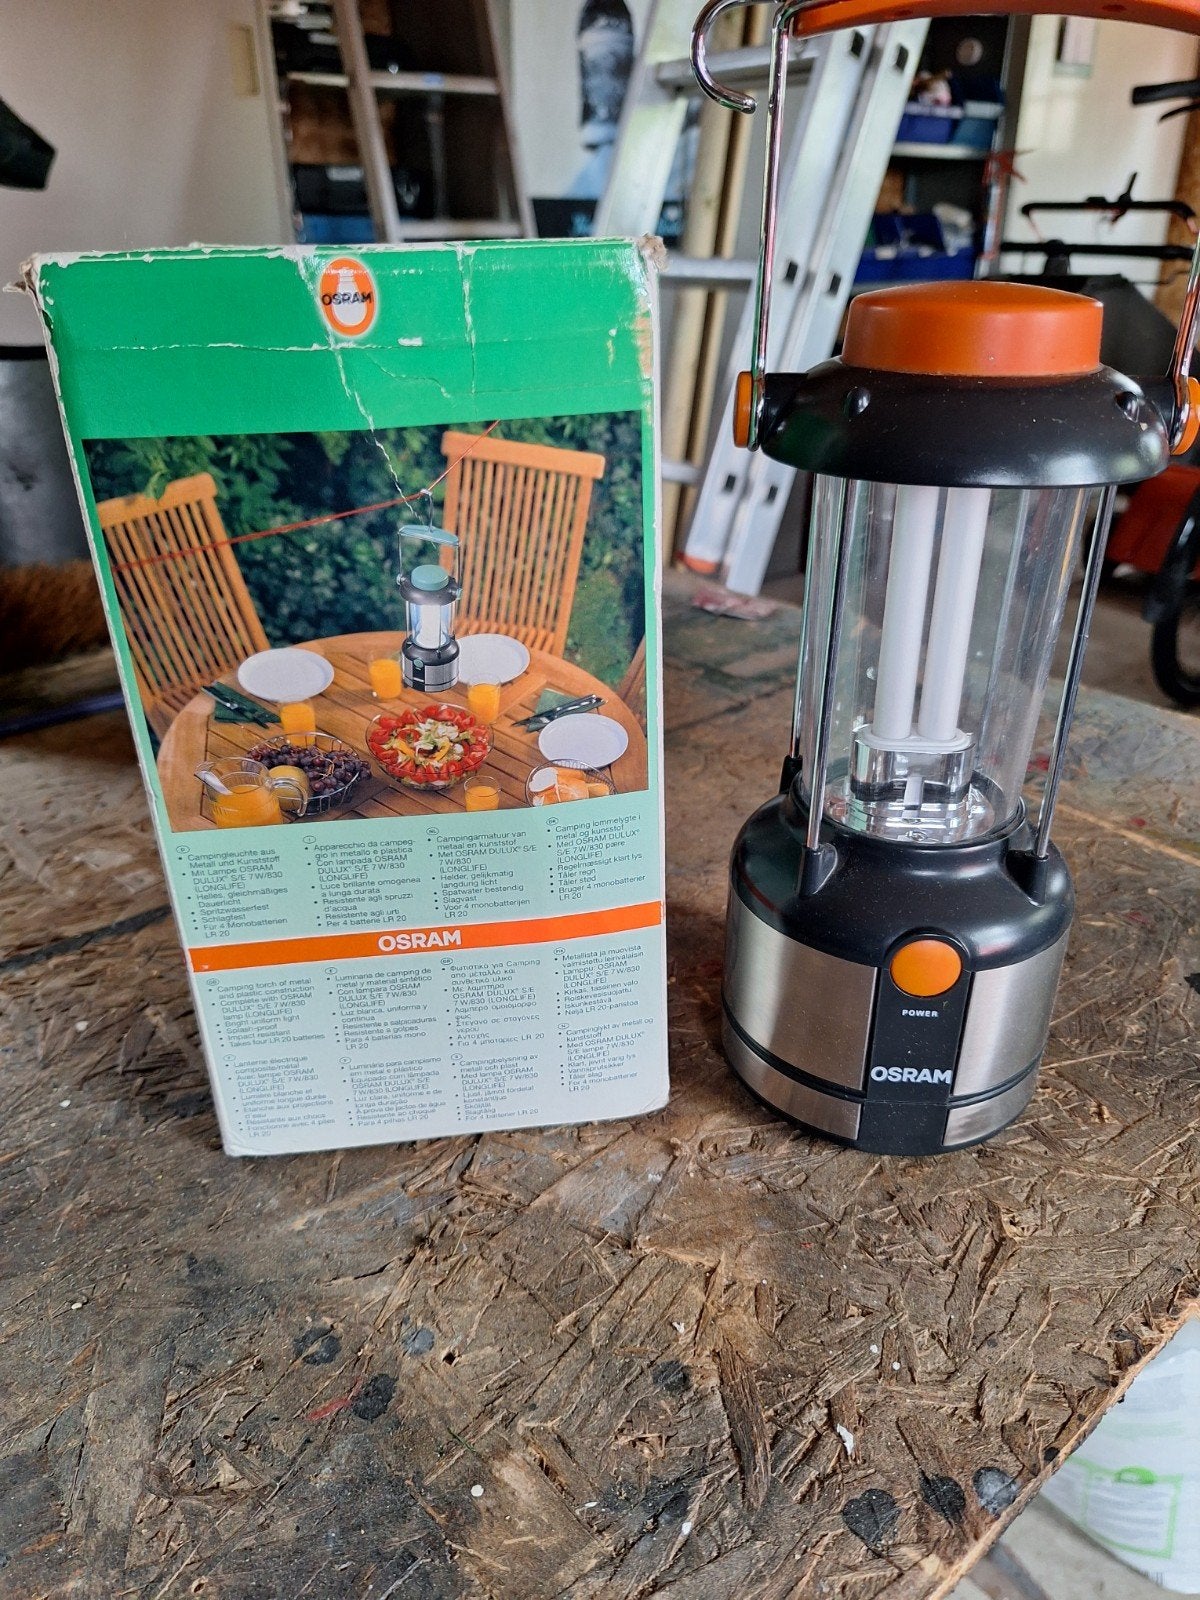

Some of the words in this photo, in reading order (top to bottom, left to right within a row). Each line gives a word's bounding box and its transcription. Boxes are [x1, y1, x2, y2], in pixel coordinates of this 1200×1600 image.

[322, 292, 372, 306] OSRAM
[556, 823, 590, 832] Camping
[556, 830, 577, 840] metal
[479, 839, 516, 847] kunststof
[556, 840, 574, 848] Med
[576, 835, 606, 845] OSRAM
[314, 843, 365, 852] Apparecchio
[380, 845, 412, 855] plastica
[455, 849, 486, 857] OSRAM
[558, 851, 602, 864] (LONGLIFE)
[237, 856, 280, 864] Kunststoff
[239, 864, 273, 872] OSRAM
[440, 864, 487, 873] (LONGLIFE)
[319, 872, 368, 882] (LONGLIFE)
[443, 896, 477, 904] Slagvast
[378, 930, 462, 952] OSRAM
[598, 961, 627, 970] OSRAM
[280, 992, 312, 1000] OSRAM
[902, 1009, 938, 1017] POWER
[870, 1066, 952, 1084] OSRAM
